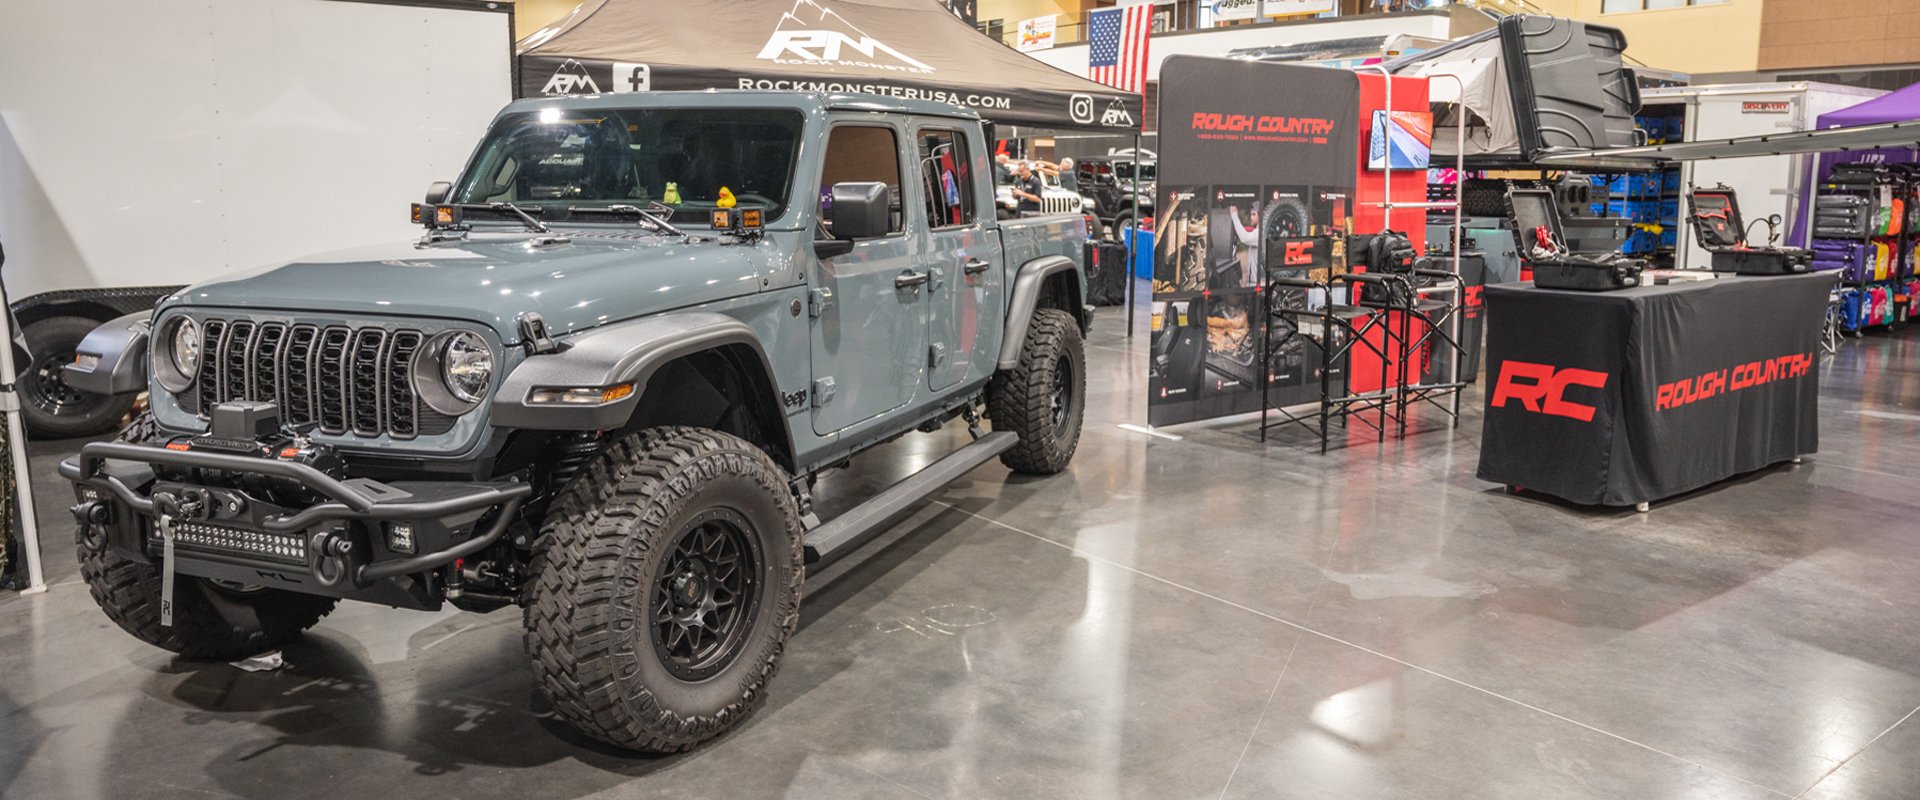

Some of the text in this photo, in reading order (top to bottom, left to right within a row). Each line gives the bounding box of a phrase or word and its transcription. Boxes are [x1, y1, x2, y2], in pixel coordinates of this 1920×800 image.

[838, 60, 935, 75] MONSTER
[738, 77, 1011, 109] ROCKMONSTERUSA.COM
[1191, 112, 1335, 135] ROUGH COUNTRY
[1284, 241, 1314, 265] RC
[1491, 359, 1609, 423] RC
[1655, 352, 1813, 413] ROUGH COUNTRY
